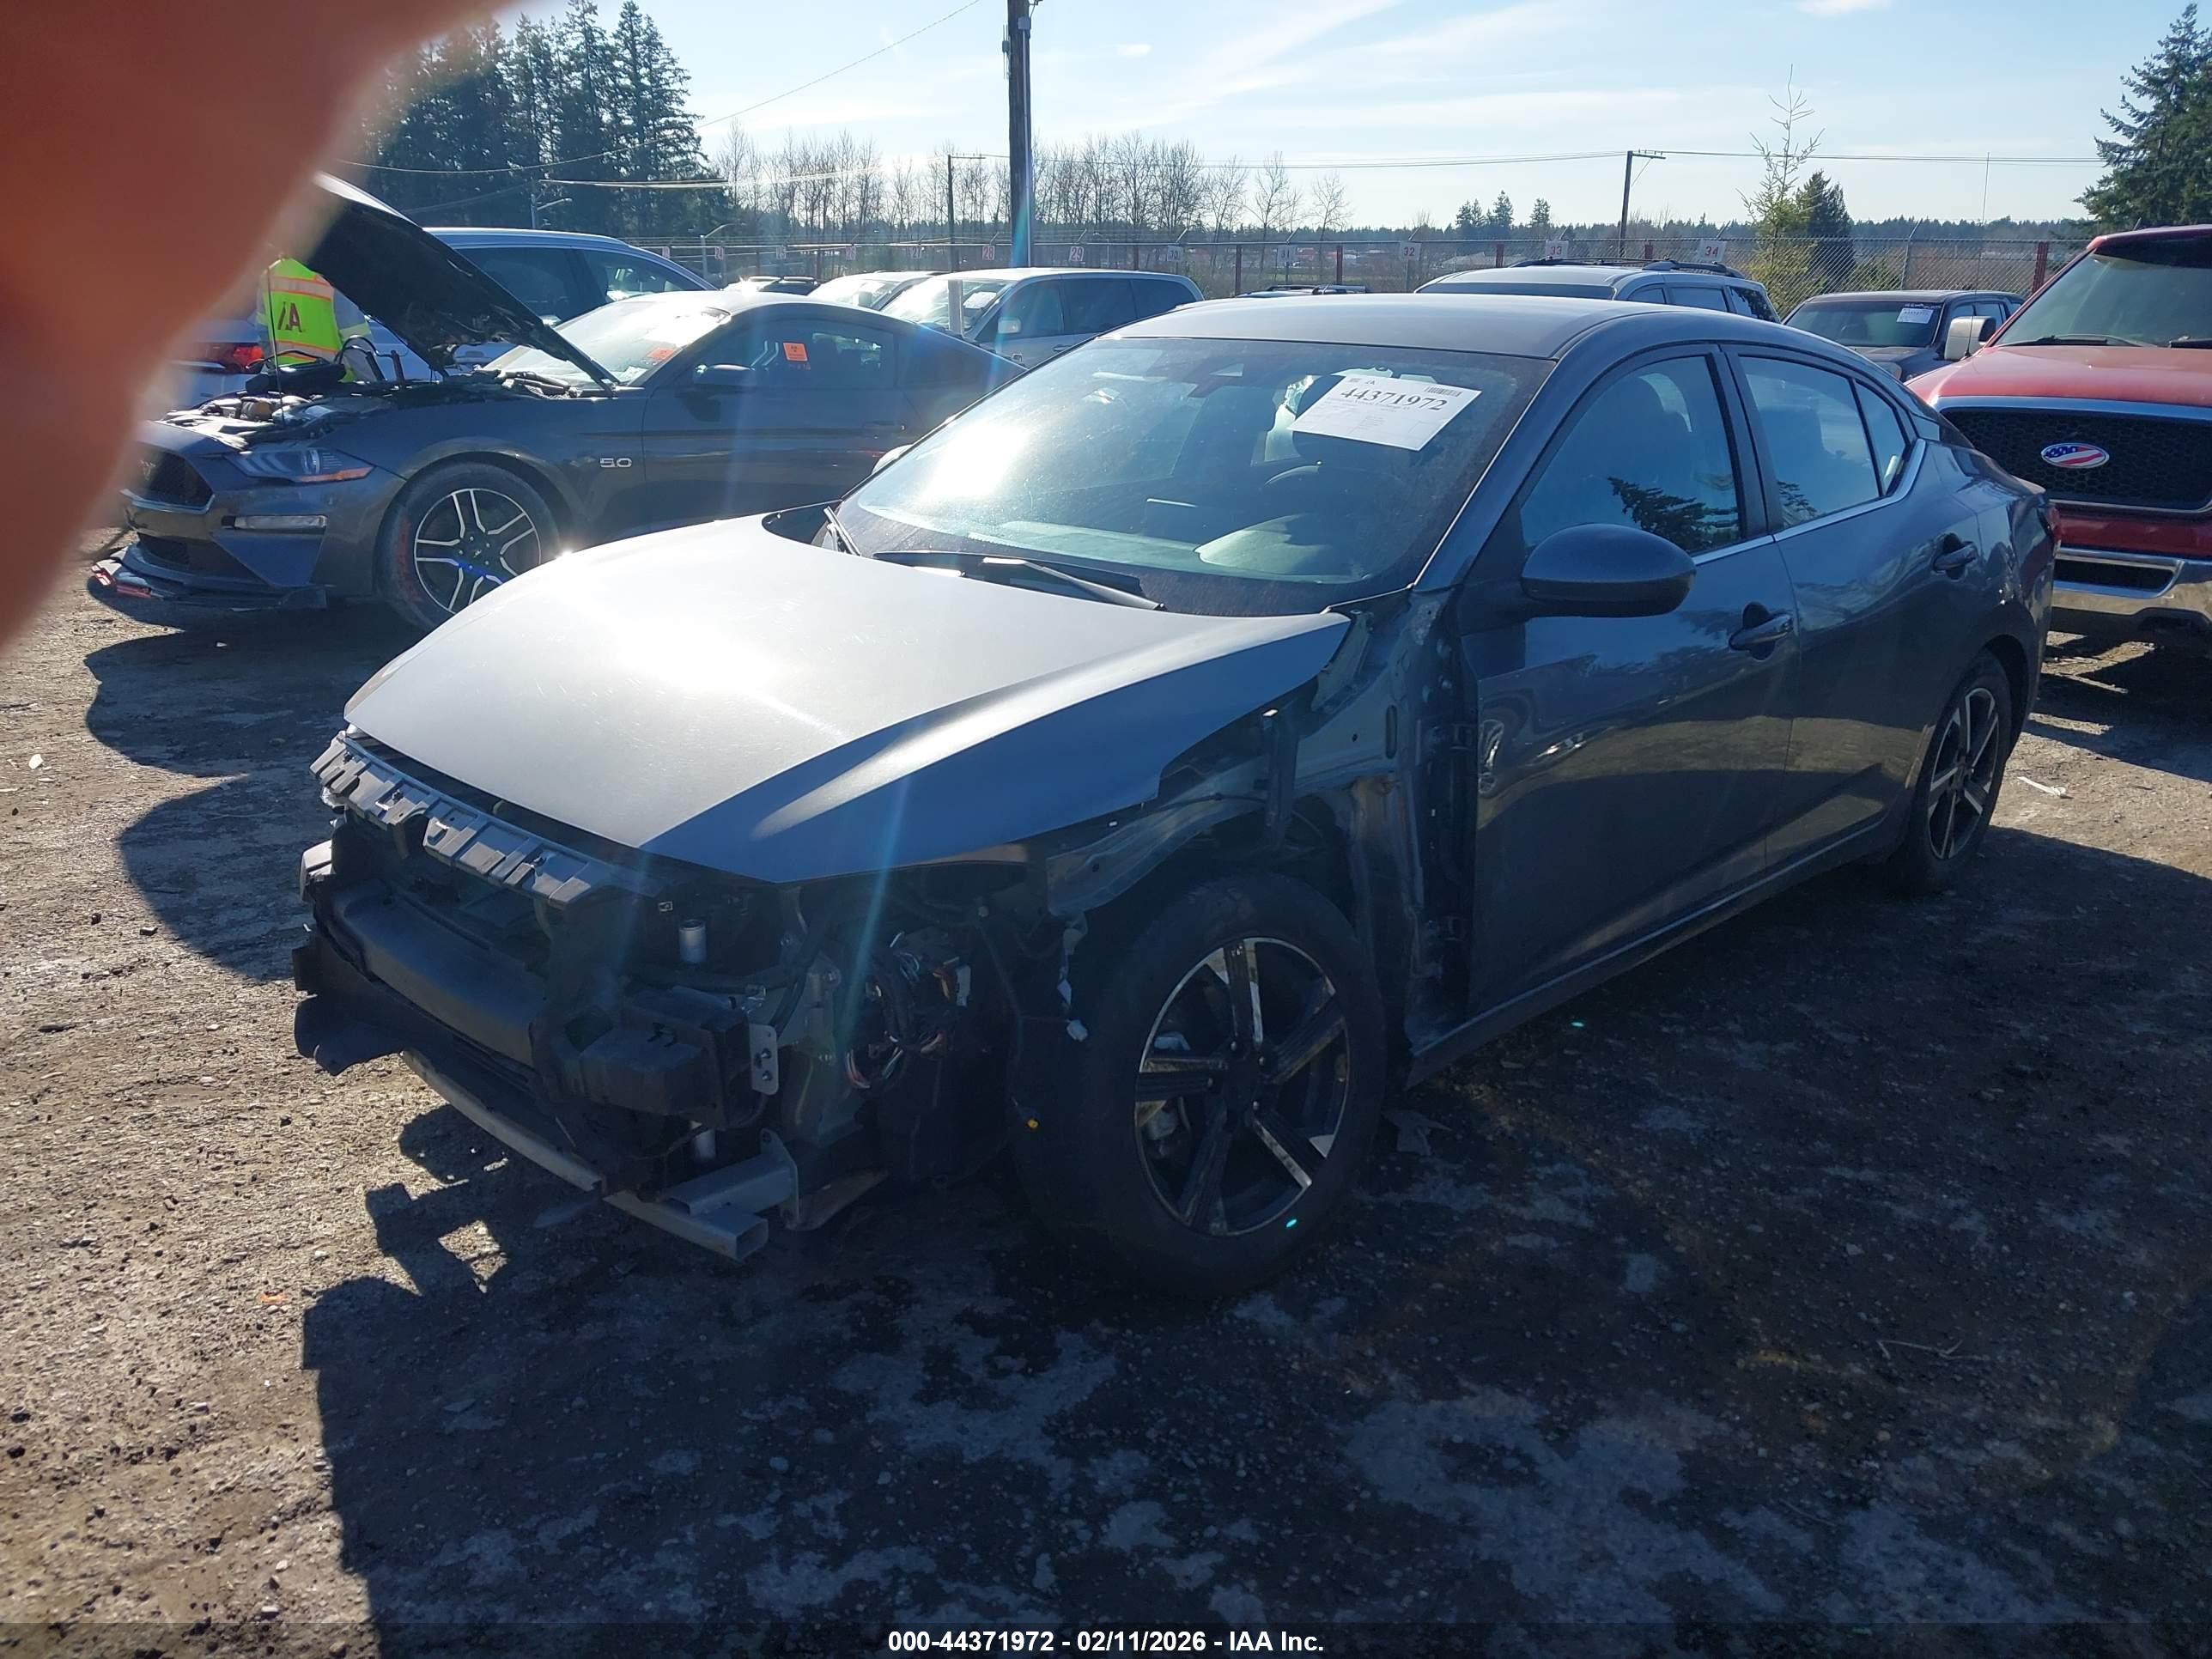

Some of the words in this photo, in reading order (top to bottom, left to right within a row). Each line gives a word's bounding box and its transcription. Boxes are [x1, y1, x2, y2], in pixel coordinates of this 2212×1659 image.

[982, 246, 994, 259] 28
[1071, 246, 1084, 261] 29
[1403, 246, 1416, 257] 32
[1549, 246, 1563, 256] 33
[1705, 246, 1719, 258] 34
[1340, 387, 1448, 411] 44371972
